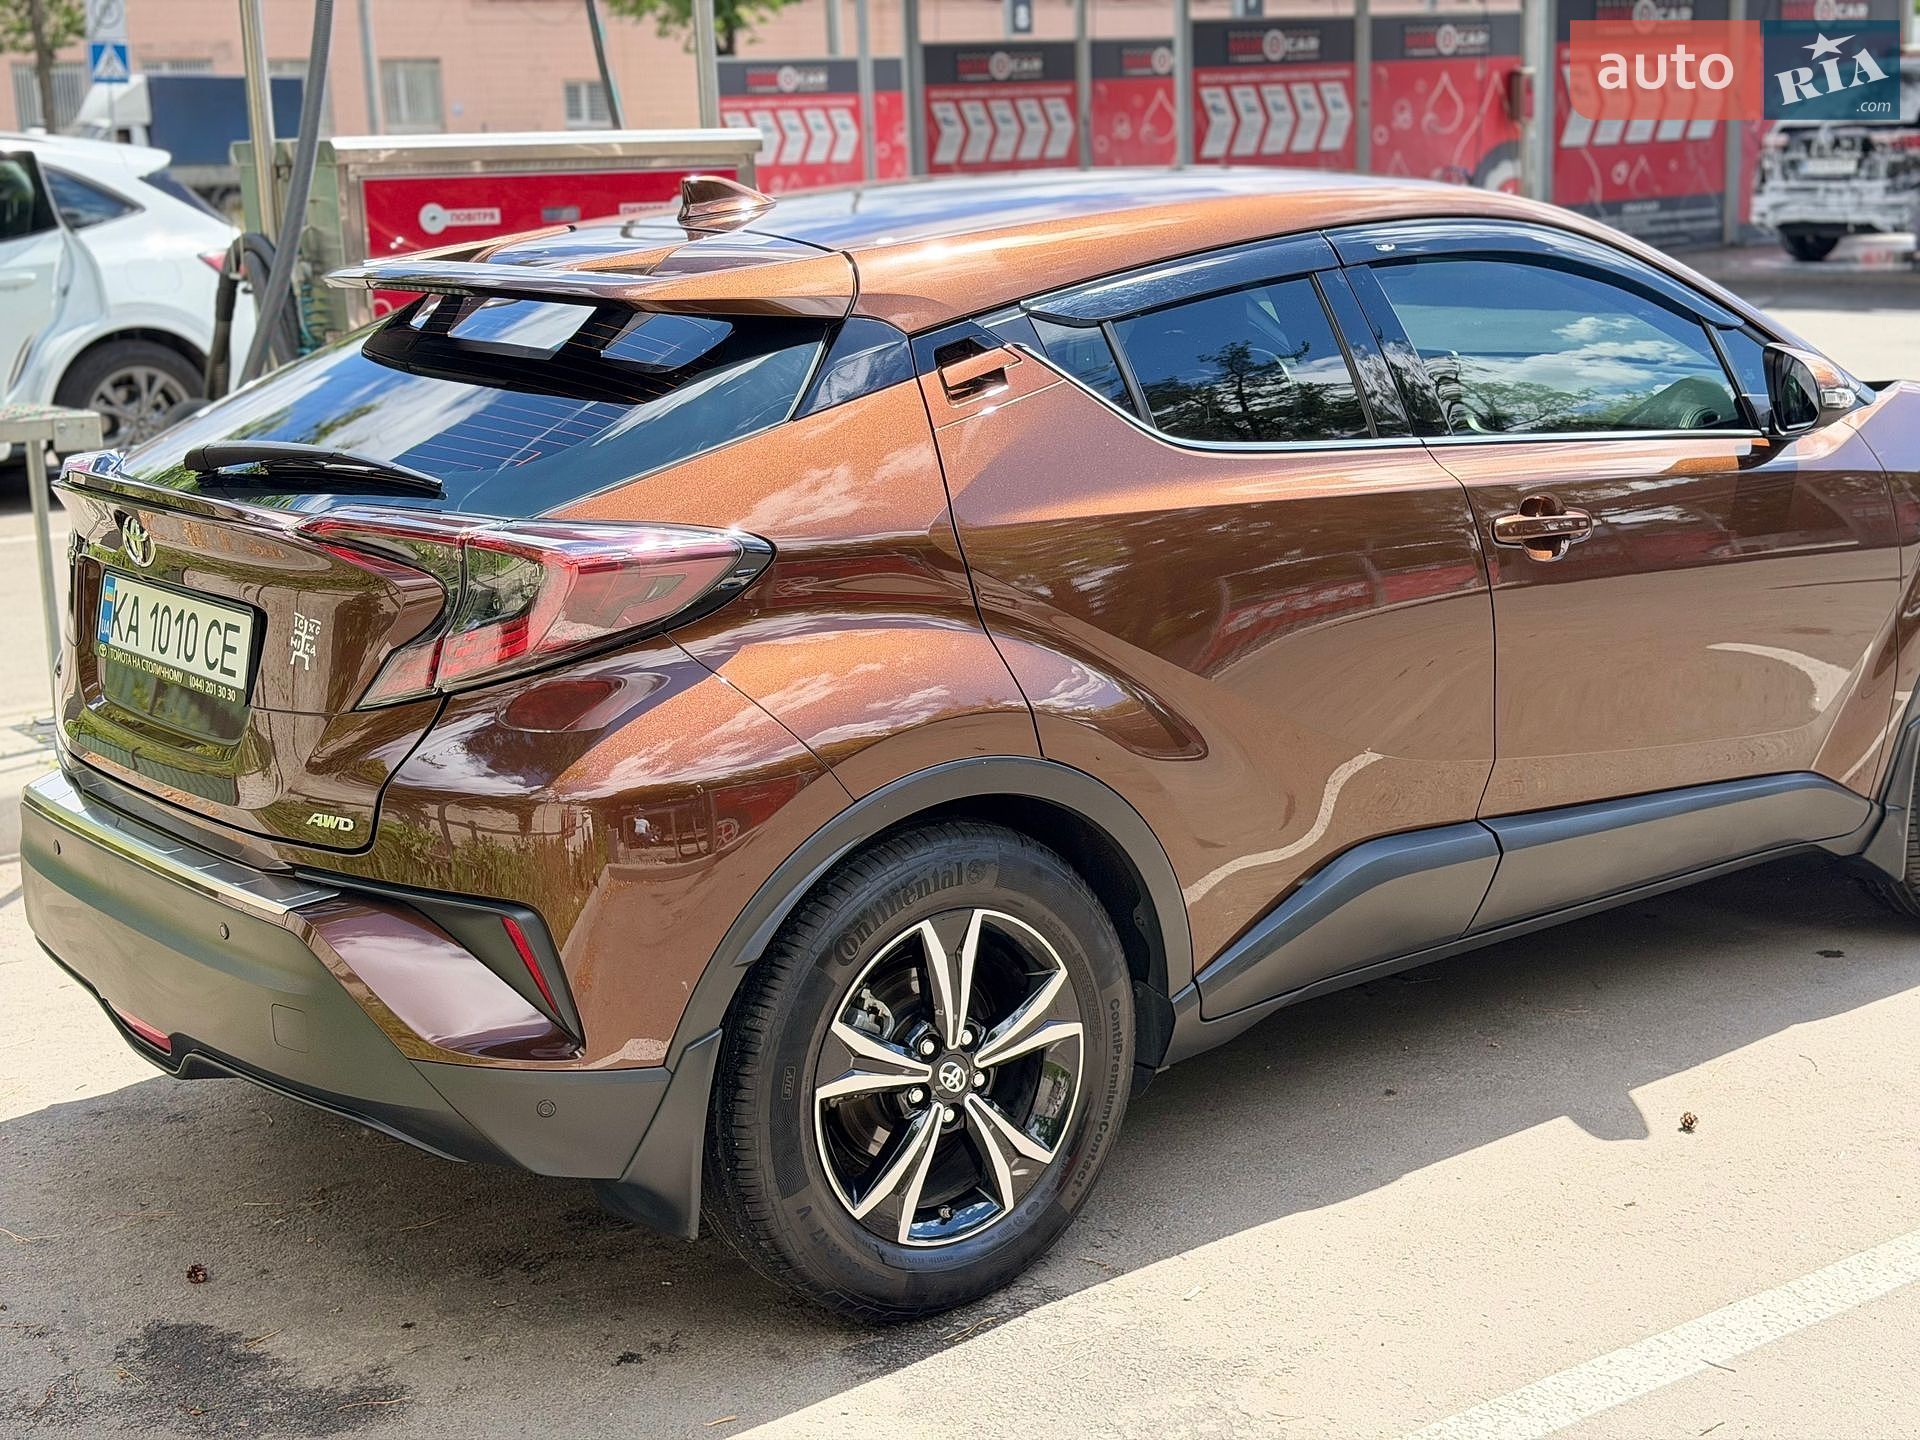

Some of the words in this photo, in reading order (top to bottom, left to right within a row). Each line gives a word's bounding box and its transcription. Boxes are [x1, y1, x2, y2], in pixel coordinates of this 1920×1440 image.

[150, 602, 199, 663] 1010
[205, 618, 241, 678] CE
[110, 647, 132, 666] ТОЙОТА
[132, 655, 141, 669] НА
[190, 674, 205, 693] (044)
[205, 680, 217, 696] 201
[217, 685, 227, 699] 30
[227, 688, 236, 702] 30
[306, 812, 354, 832] AWD
[1074, 998, 1121, 1188] ContiPremiumContact
